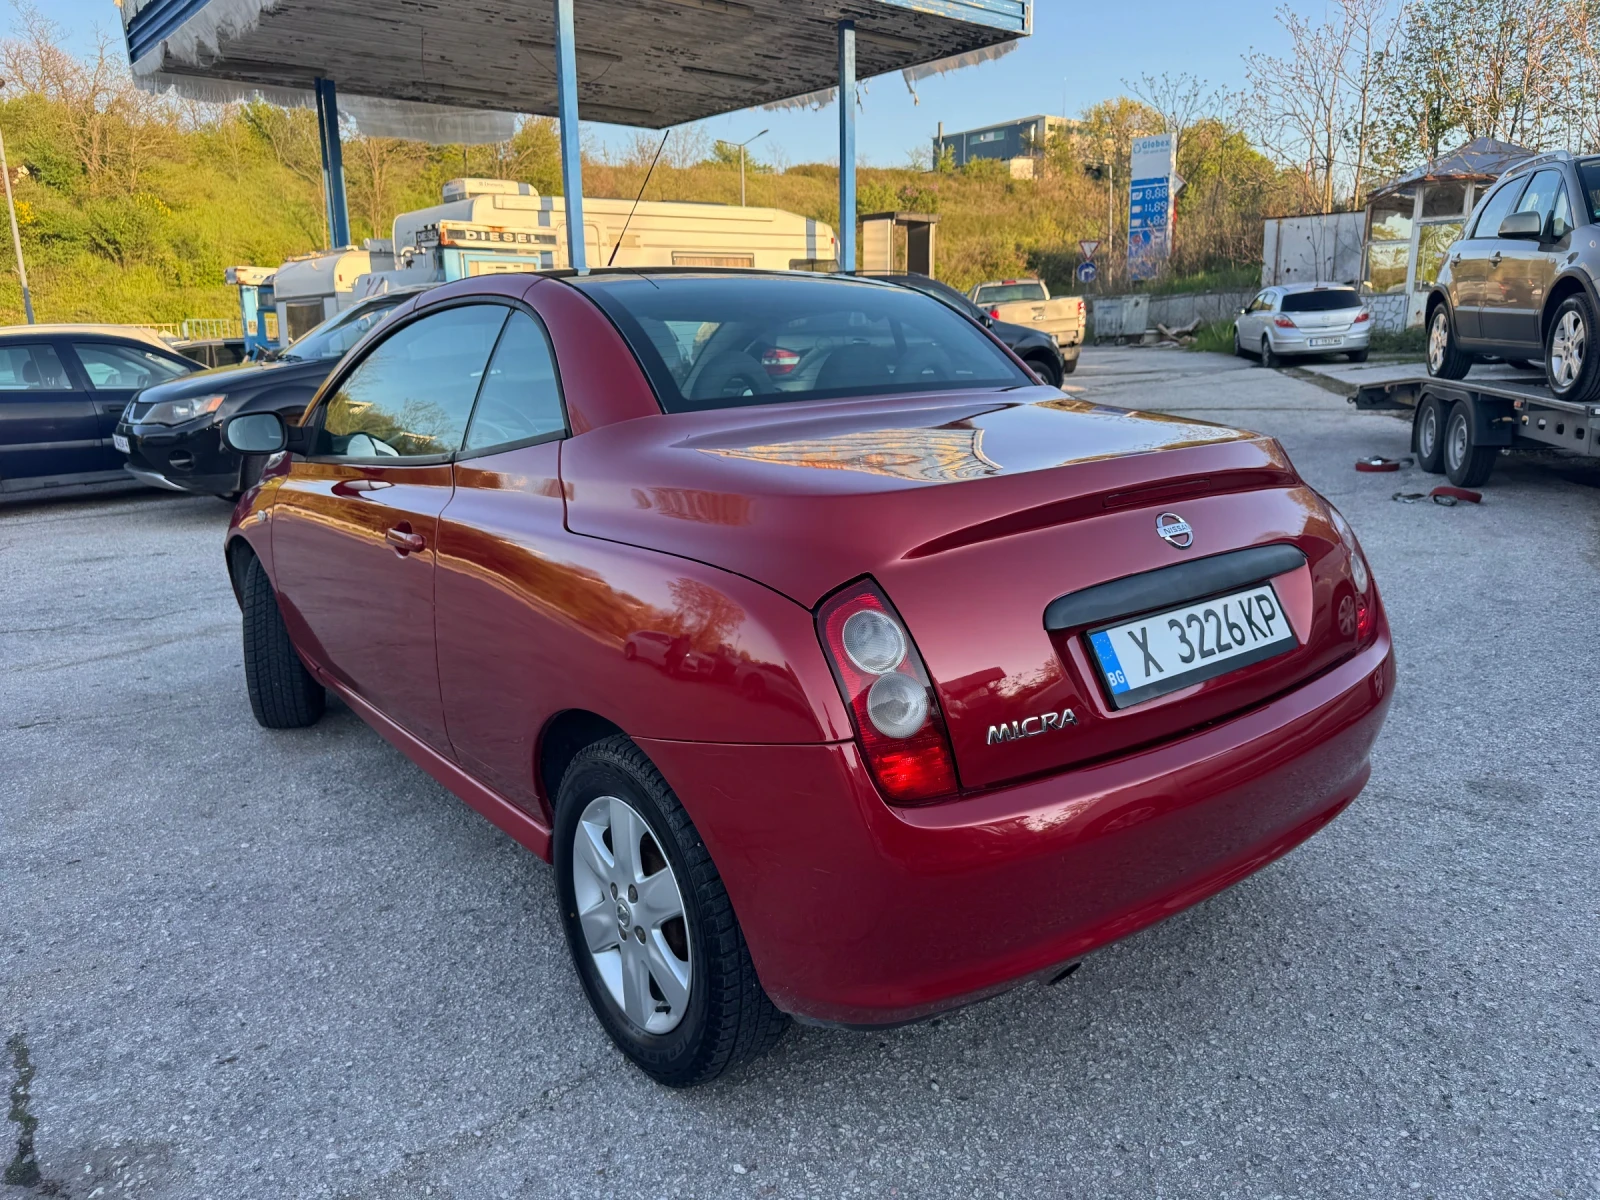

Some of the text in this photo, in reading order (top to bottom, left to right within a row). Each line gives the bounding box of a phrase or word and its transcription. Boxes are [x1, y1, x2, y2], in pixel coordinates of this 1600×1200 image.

[1142, 140, 1170, 149] Globex
[466, 230, 541, 245] DIESEL
[1126, 627, 1164, 678] X
[1108, 670, 1125, 687] BG
[986, 708, 1079, 746] MICRA
